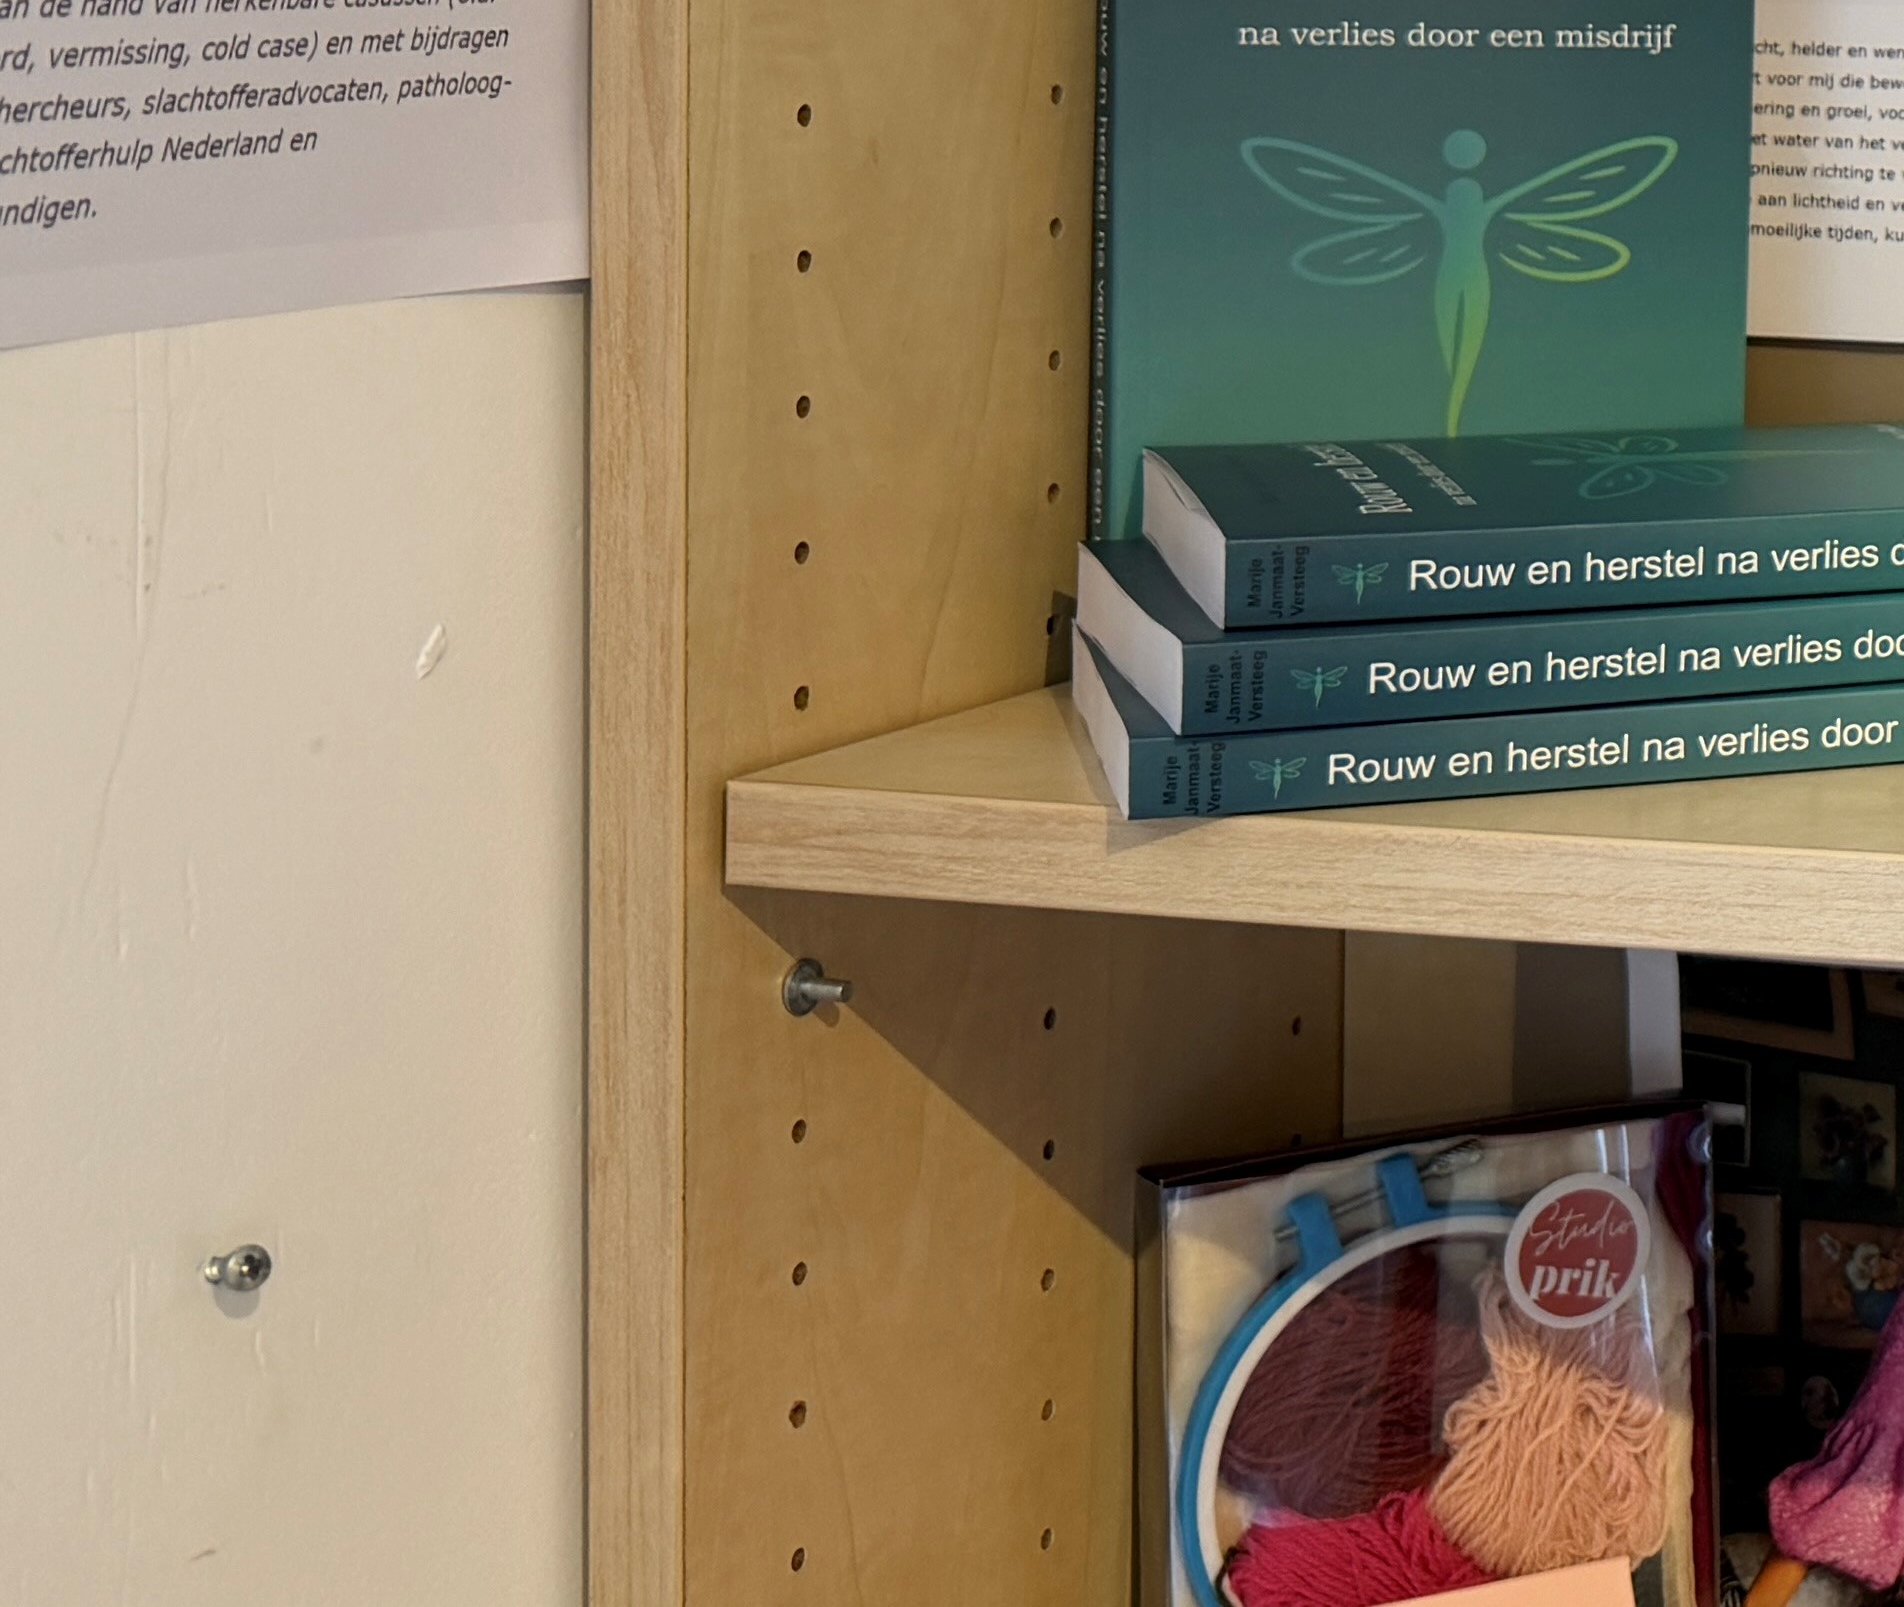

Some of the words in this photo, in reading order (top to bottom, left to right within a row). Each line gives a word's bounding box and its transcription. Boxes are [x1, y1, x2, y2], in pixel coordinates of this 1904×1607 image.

[1239, 27, 1280, 45] na
[1290, 21, 1395, 46] verlies
[1407, 22, 1479, 46] door
[1490, 30, 1544, 47] een
[1555, 24, 1677, 54] misdrijf
[1411, 560, 1515, 590] Rouw
[1528, 561, 1570, 584] en
[1586, 546, 1703, 581] herstel
[1718, 551, 1758, 574] na
[1771, 540, 1878, 571] verlies
[1370, 662, 1475, 693] Rouw
[1488, 661, 1531, 685] en
[1546, 644, 1665, 681] herstel
[1679, 648, 1720, 671] na
[1734, 634, 1841, 667] verlies
[1328, 754, 1436, 785] Rouw
[1449, 751, 1492, 776] en
[1508, 734, 1628, 772] herstel
[1643, 737, 1684, 761] na
[1698, 723, 1809, 757] verlies
[1822, 718, 1899, 748] door
[1529, 1199, 1634, 1257] Studio
[1529, 1257, 1620, 1301] prik
